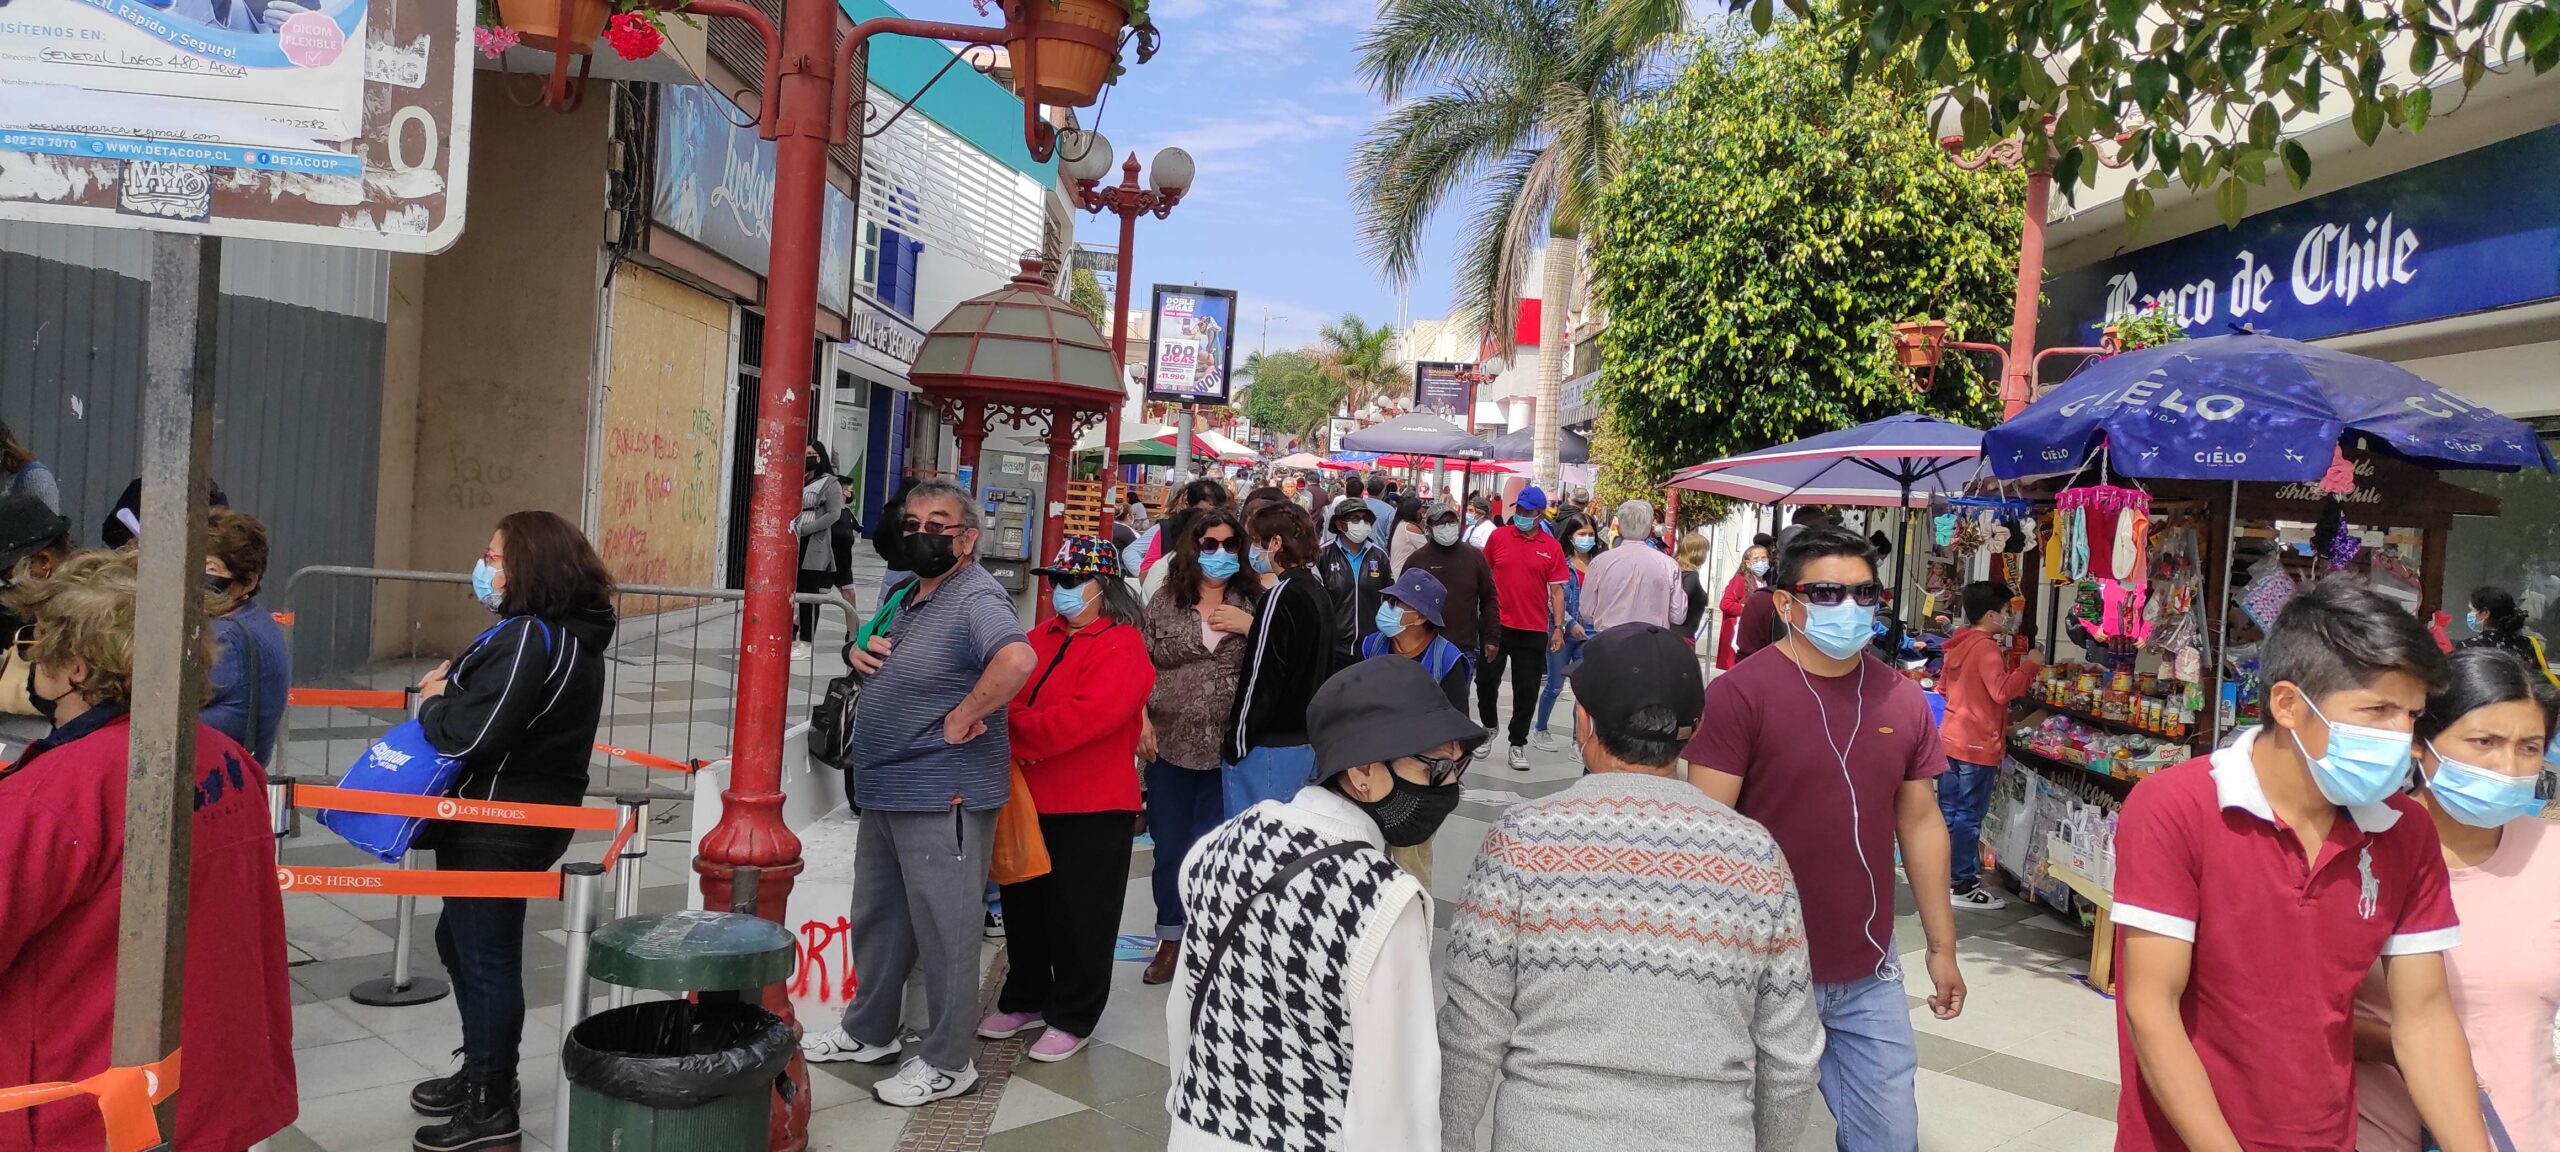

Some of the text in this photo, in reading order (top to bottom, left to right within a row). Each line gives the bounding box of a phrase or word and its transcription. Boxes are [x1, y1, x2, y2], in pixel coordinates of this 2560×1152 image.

[1, 22, 106, 40] ISÍTENOS EN:
[118, 4, 166, 34] Rápido
[168, 31, 178, 41] y
[179, 34, 237, 58] Seguro!
[292, 24, 332, 37] DICOM
[285, 36, 337, 50] FLEXIBLE
[4, 135, 77, 148] 800 20 7070
[107, 142, 231, 162] WWW.DETACOOP.CL
[271, 156, 338, 169] DETACOOP
[2105, 211, 2420, 328] Banco de Chile
[1165, 304, 1194, 312] GIGAS
[1166, 297, 1196, 306] DOBLE
[850, 306, 876, 347] TUAL
[1164, 344, 1195, 357] 100
[1161, 354, 1195, 364] GIGAS
[1193, 367, 1224, 394] WOM
[458, 805, 526, 819] LOS HEROES
[297, 874, 383, 887] LOS HEROES
